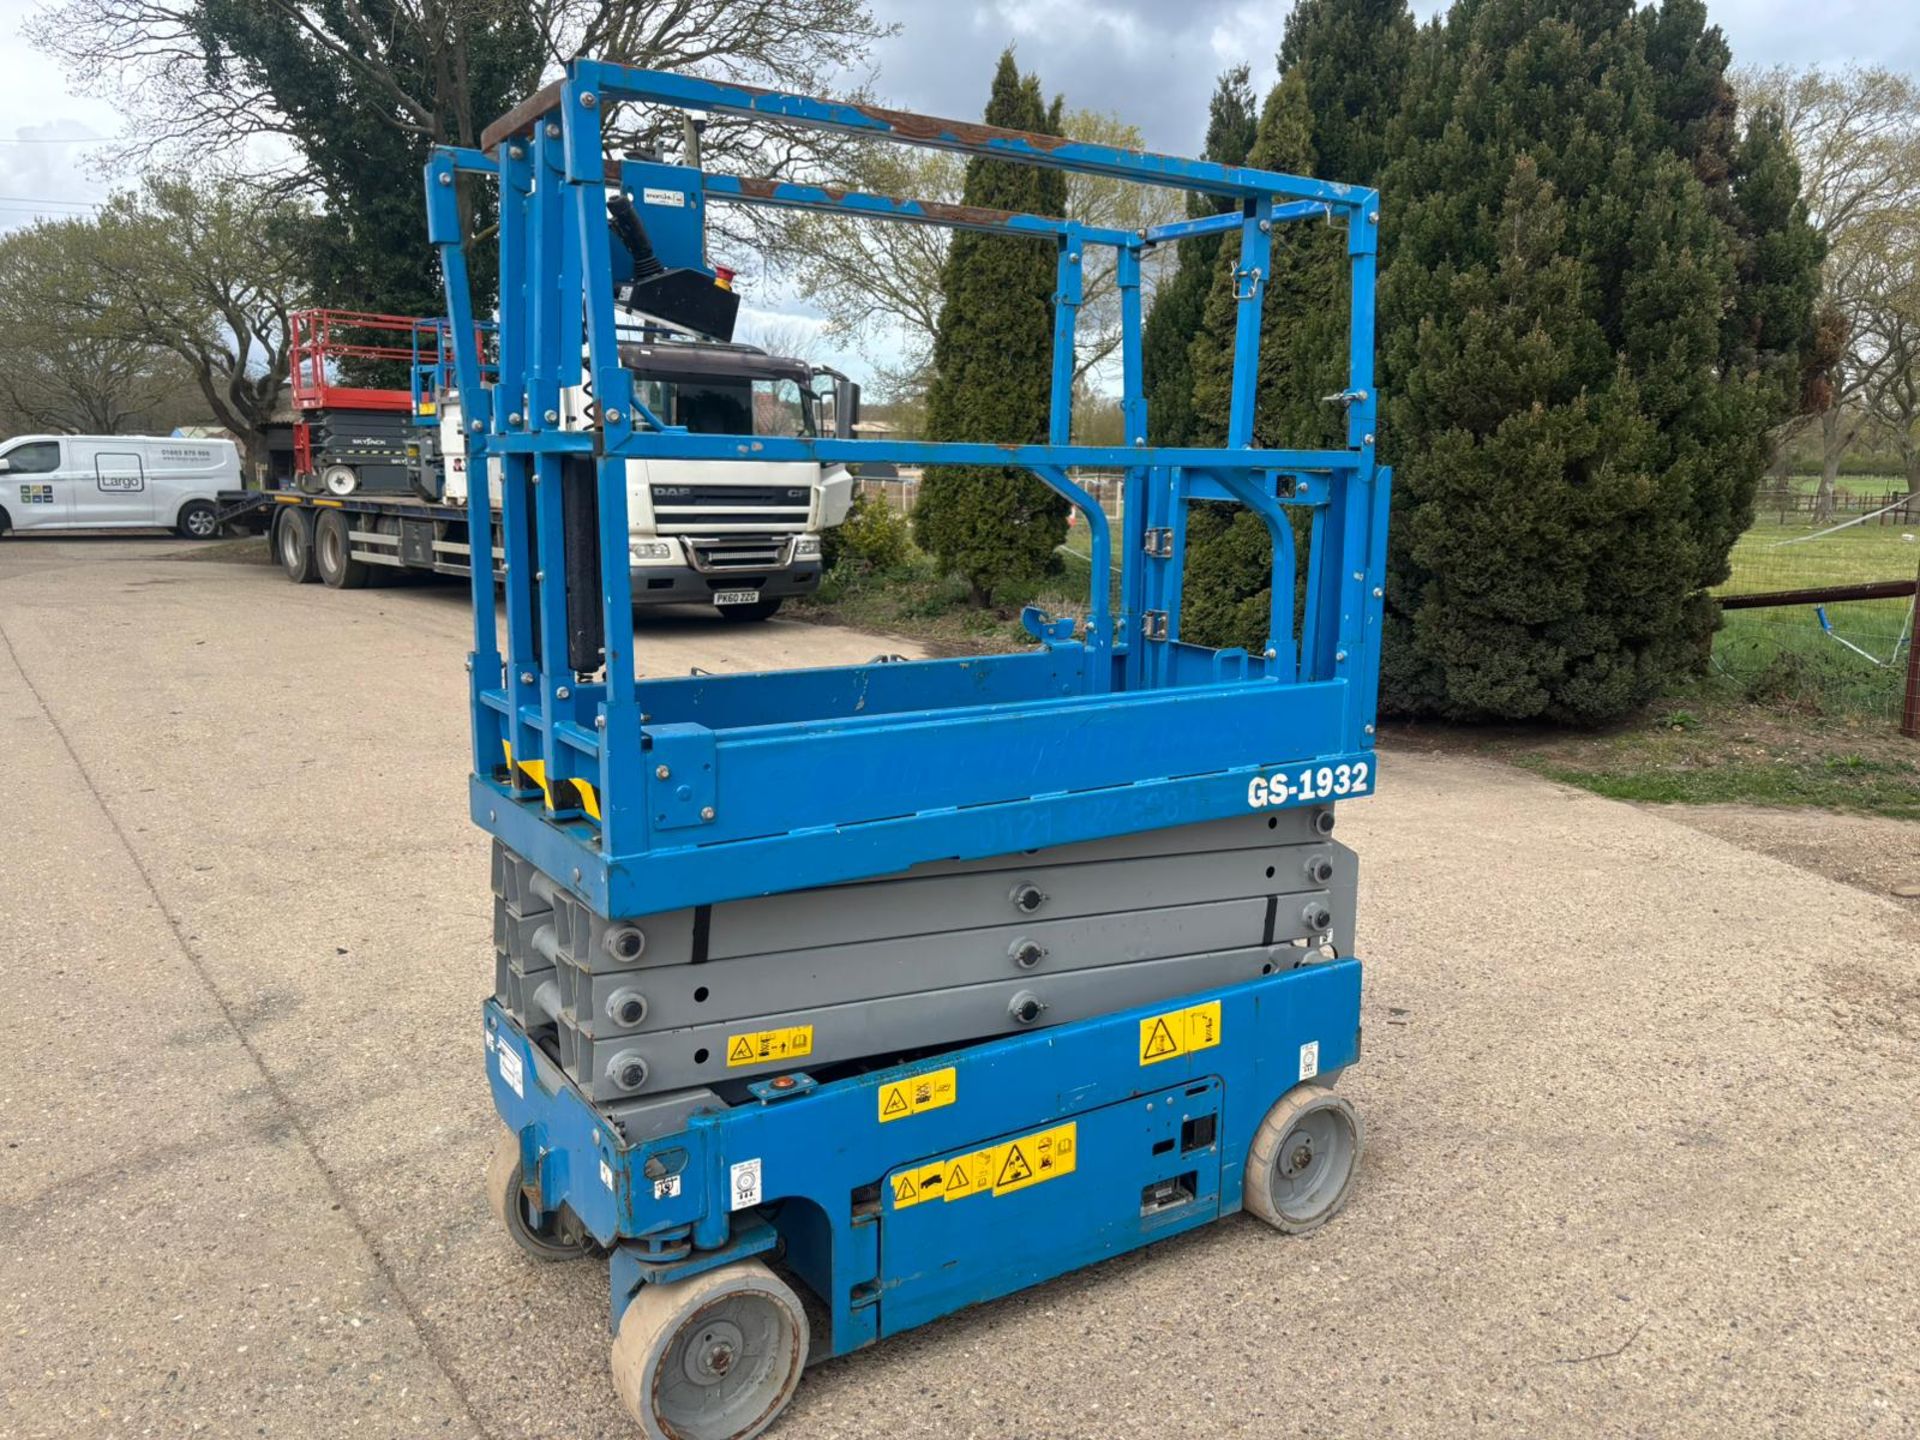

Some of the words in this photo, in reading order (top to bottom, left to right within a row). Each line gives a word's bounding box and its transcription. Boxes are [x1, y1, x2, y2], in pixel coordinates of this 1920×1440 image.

[102, 475, 139, 489] Largo
[653, 487, 691, 496] DAF
[717, 593, 739, 602] PK60
[1247, 761, 1370, 809] GS-1932
